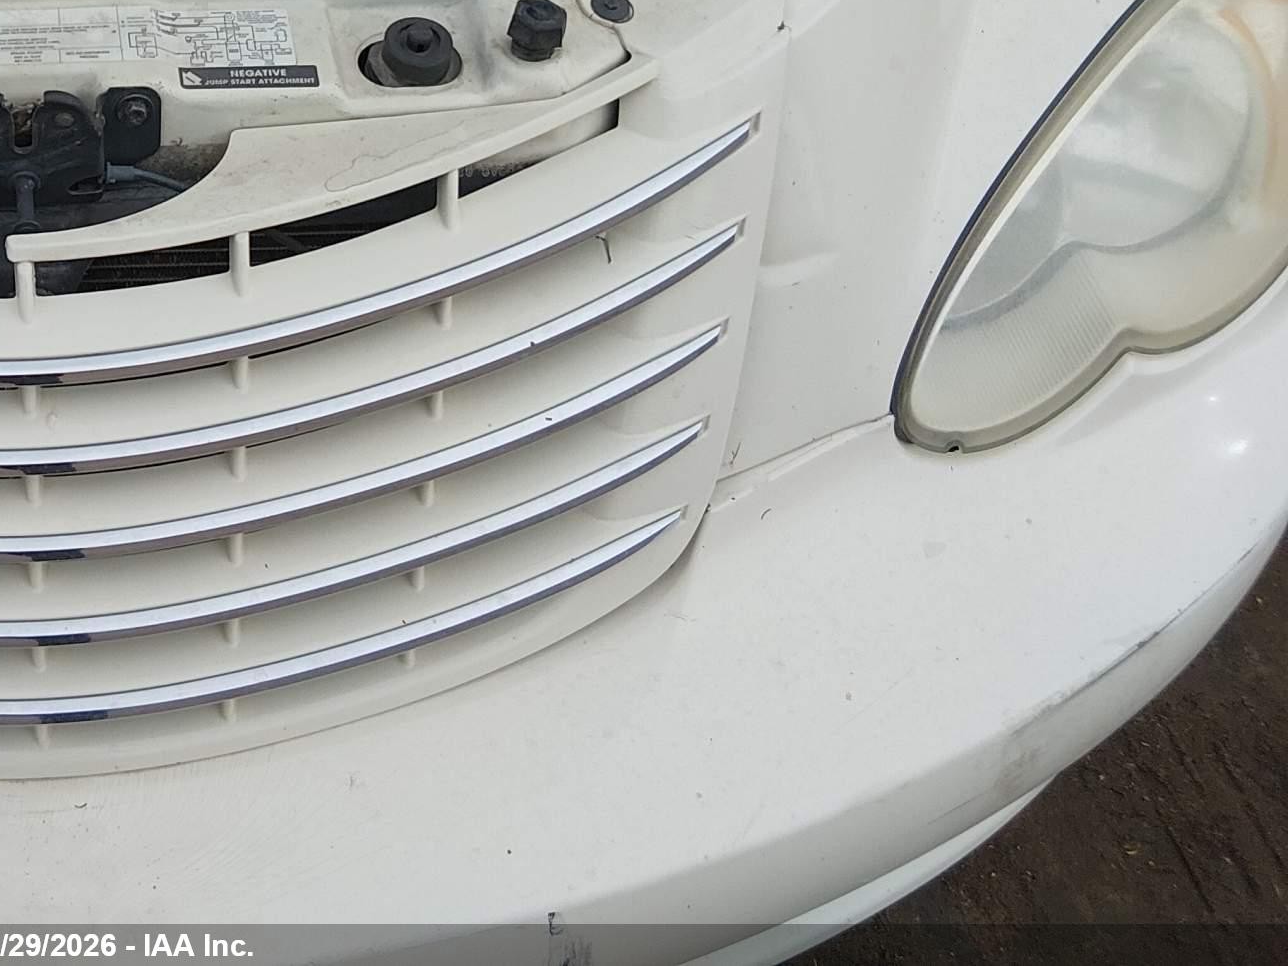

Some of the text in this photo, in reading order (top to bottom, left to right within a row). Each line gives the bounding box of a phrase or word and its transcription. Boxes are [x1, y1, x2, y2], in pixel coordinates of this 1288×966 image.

[230, 68, 287, 77] NEGATIVE
[206, 78, 229, 86] JUMP
[230, 77, 257, 85] START
